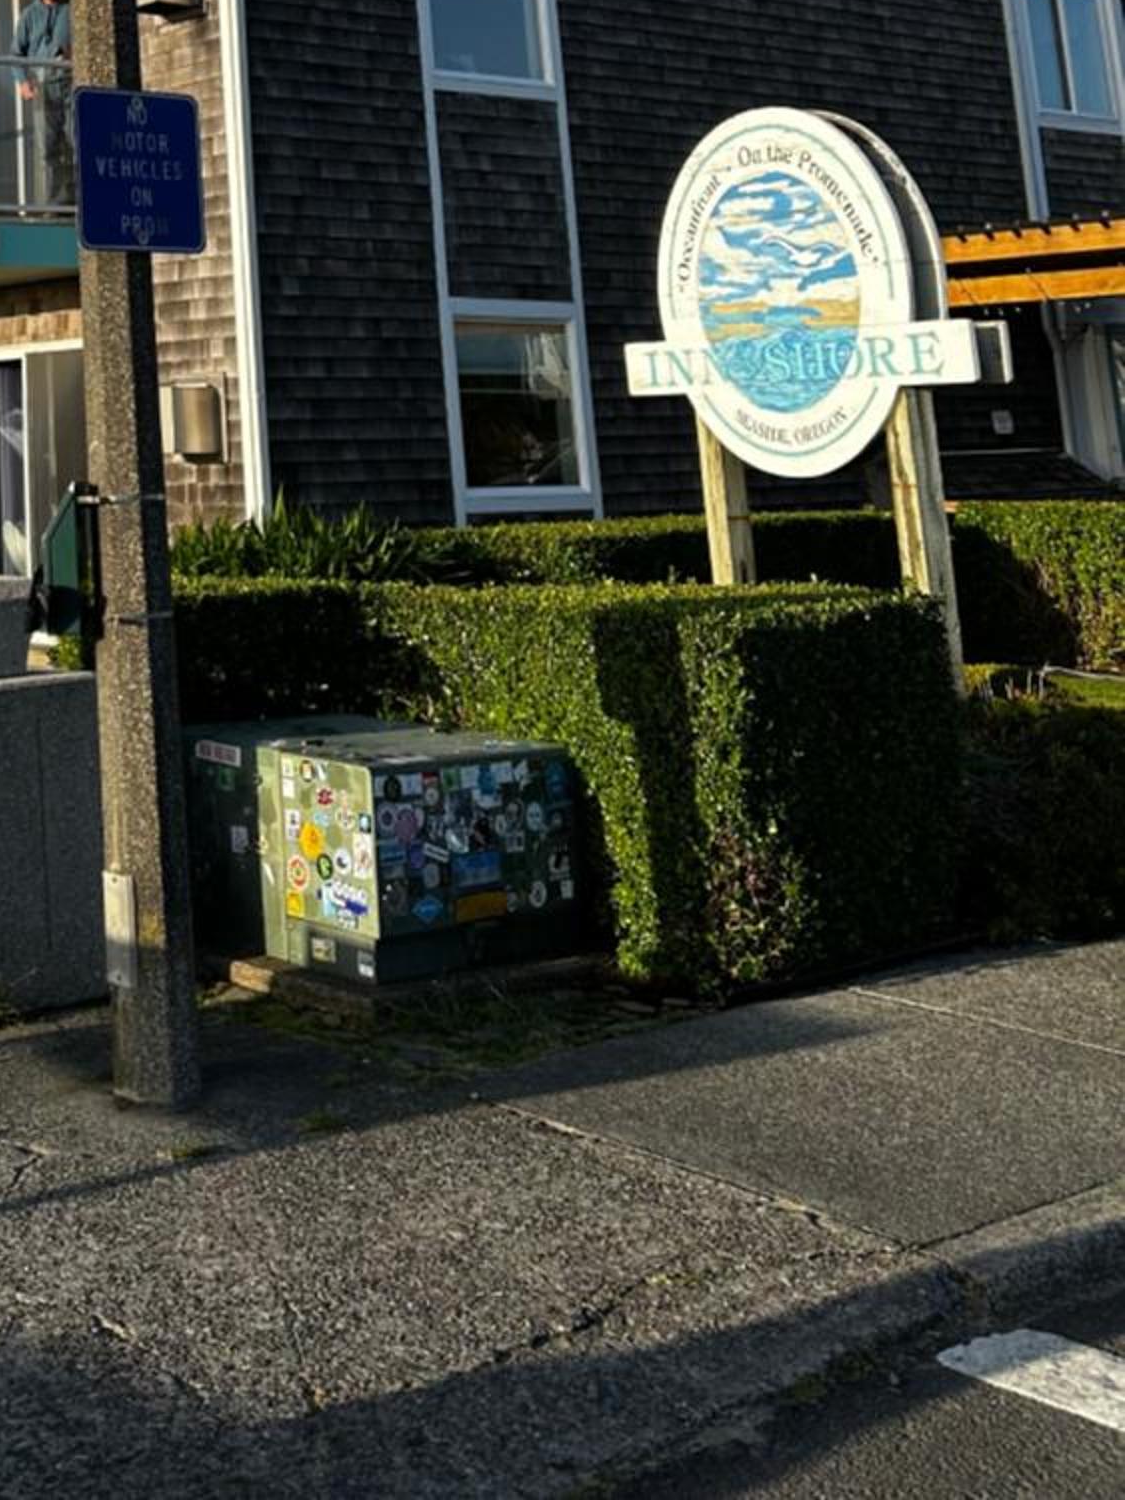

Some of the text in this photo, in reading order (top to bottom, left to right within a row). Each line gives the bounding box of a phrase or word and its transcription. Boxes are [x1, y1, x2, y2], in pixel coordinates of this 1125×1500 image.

[126, 105, 148, 126] NO
[110, 131, 170, 155] MOTOR
[94, 156, 183, 181] VEHICLES
[130, 185, 155, 208] ON
[737, 146, 762, 167] On
[767, 144, 793, 164] the
[798, 150, 874, 258] Promenade
[763, 330, 946, 384] SHORE
[794, 406, 848, 445] OREGON
